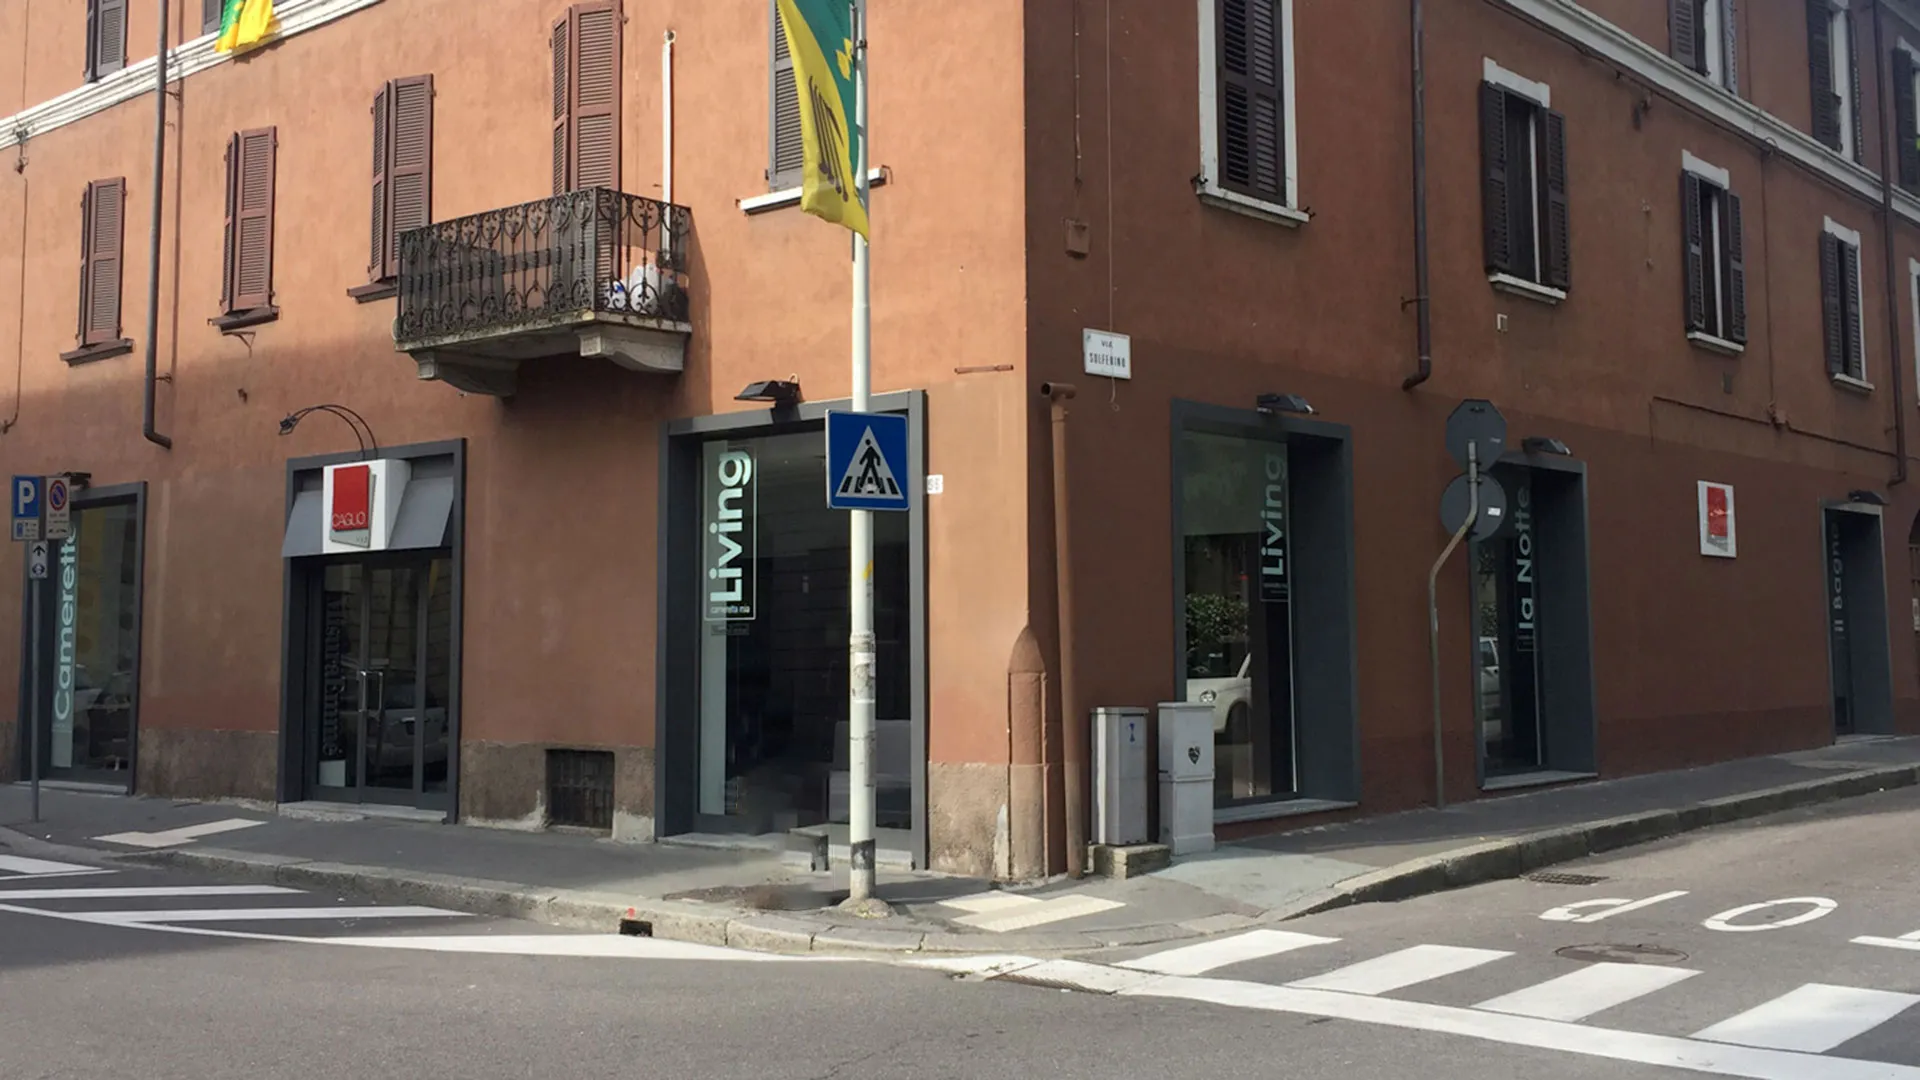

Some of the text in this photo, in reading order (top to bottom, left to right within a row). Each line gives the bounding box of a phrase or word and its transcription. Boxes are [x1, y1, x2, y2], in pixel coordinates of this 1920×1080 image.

[1089, 352, 1126, 368] SOLFERINO
[1101, 339, 1113, 348] VIA
[18, 480, 36, 515] P
[1260, 452, 1286, 576] Living
[709, 449, 752, 602] Living
[1514, 485, 1534, 583] Notte
[1518, 597, 1535, 630] la
